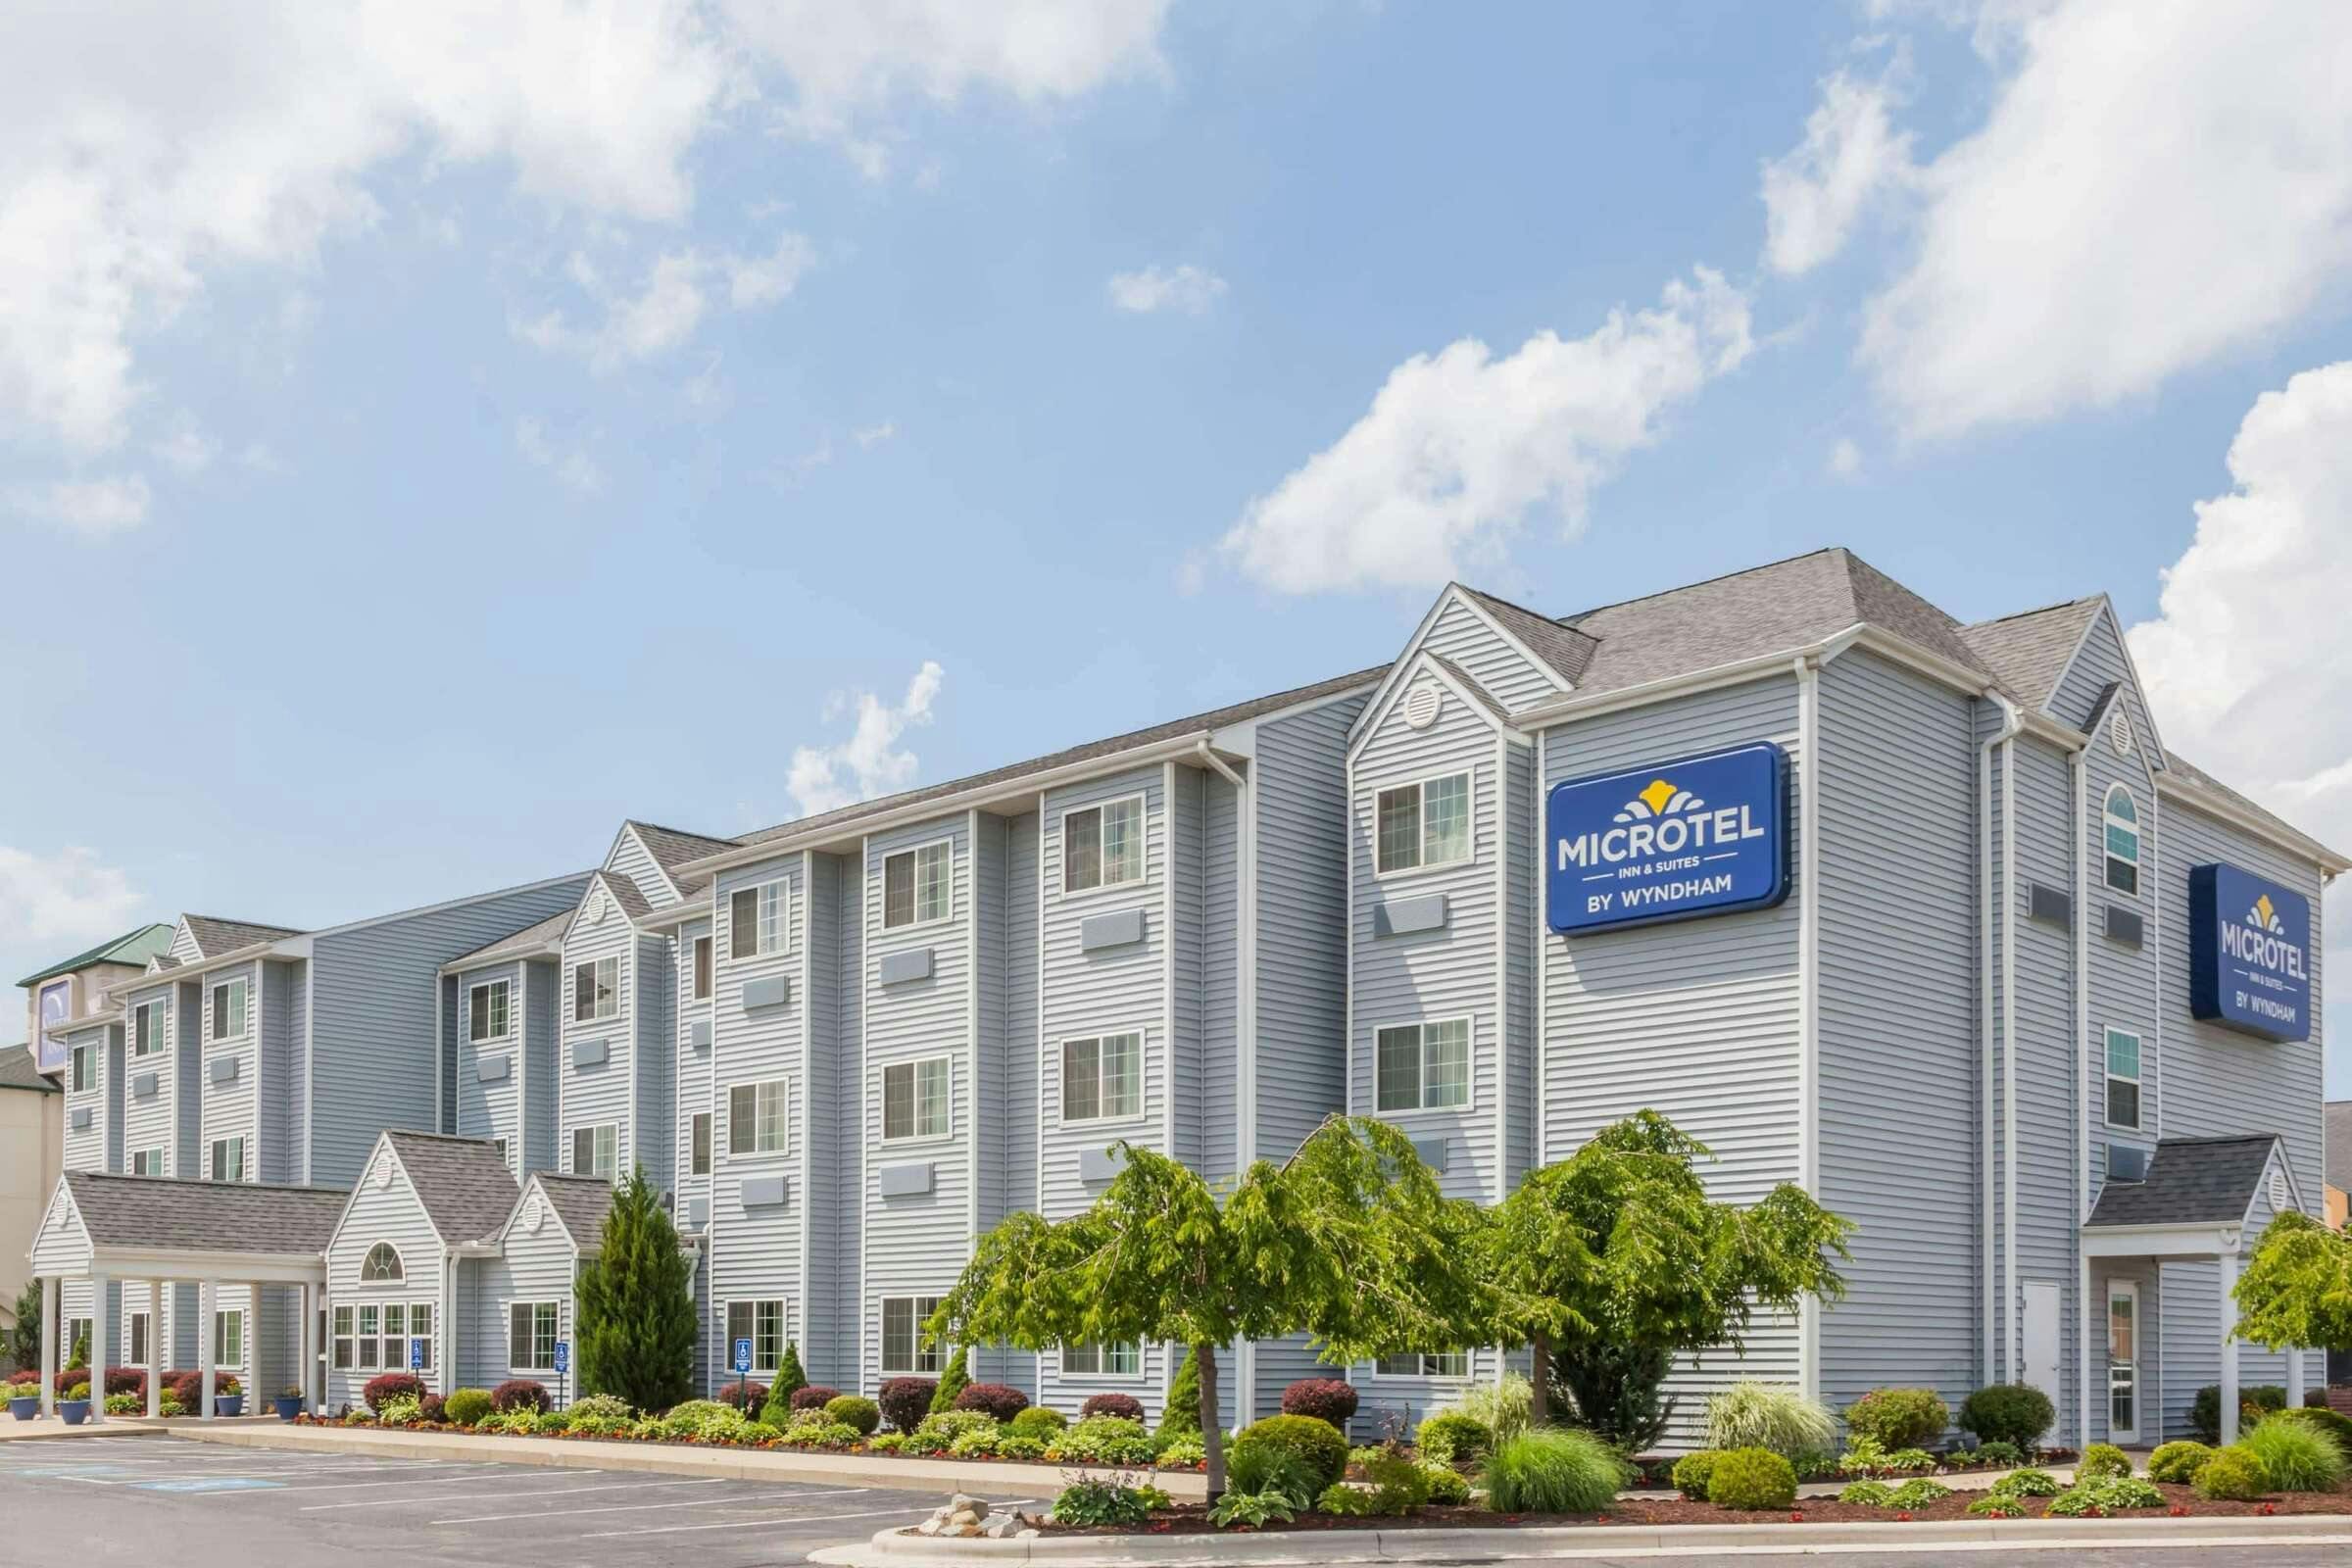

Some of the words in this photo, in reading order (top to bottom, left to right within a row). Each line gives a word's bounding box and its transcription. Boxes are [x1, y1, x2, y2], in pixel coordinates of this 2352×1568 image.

[1558, 805, 1764, 871] MICROTEL
[1618, 866, 1641, 879] INN
[1643, 863, 1653, 875] &
[1655, 856, 1700, 873] SUITES
[1588, 893, 1612, 913] BY
[1621, 874, 1732, 907] WYNDHAM
[2221, 920, 2307, 981] MICROTEL
[2235, 991, 2249, 1008] BY
[2251, 997, 2296, 1023] WYNDHAM
